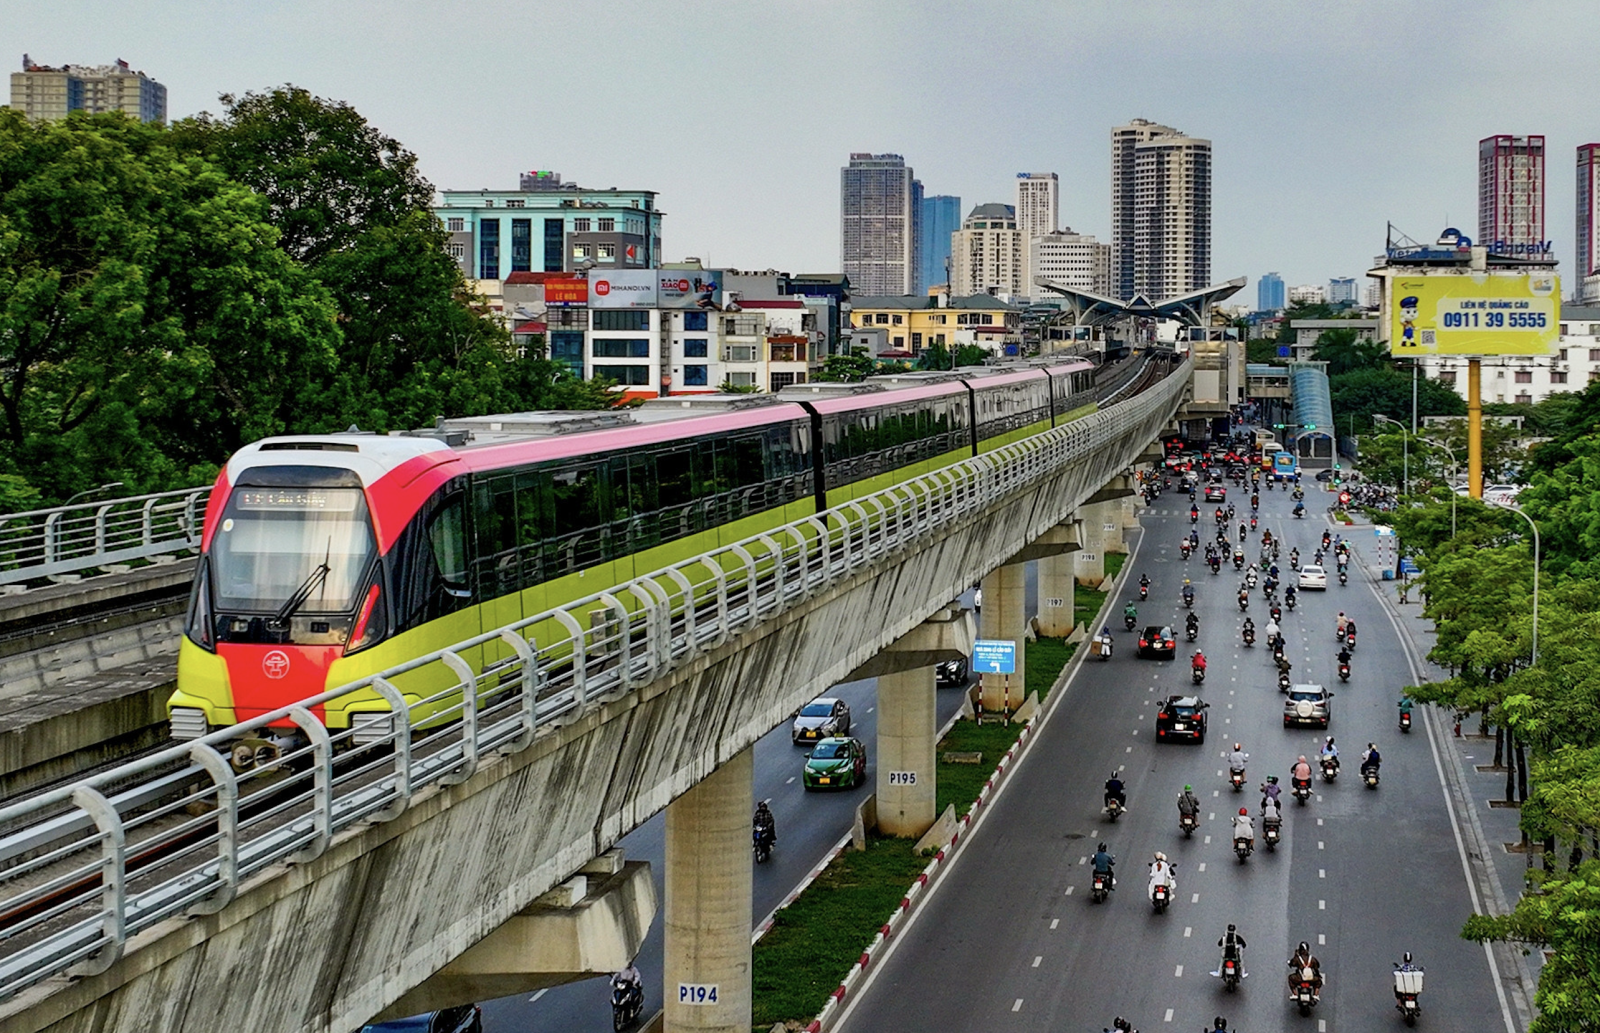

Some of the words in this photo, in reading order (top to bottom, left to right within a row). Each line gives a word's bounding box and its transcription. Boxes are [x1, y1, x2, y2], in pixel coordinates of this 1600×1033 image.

[1460, 301, 1476, 309] LIÊN
[1478, 301, 1487, 311] HỆ
[1489, 299, 1512, 310] QUẢNG
[1514, 301, 1529, 309] CÁO
[1444, 312, 1478, 328] 0911
[1485, 312, 1504, 328] 39
[1508, 312, 1546, 328] 5555
[890, 772, 916, 784] P195
[680, 986, 718, 1003] P194
